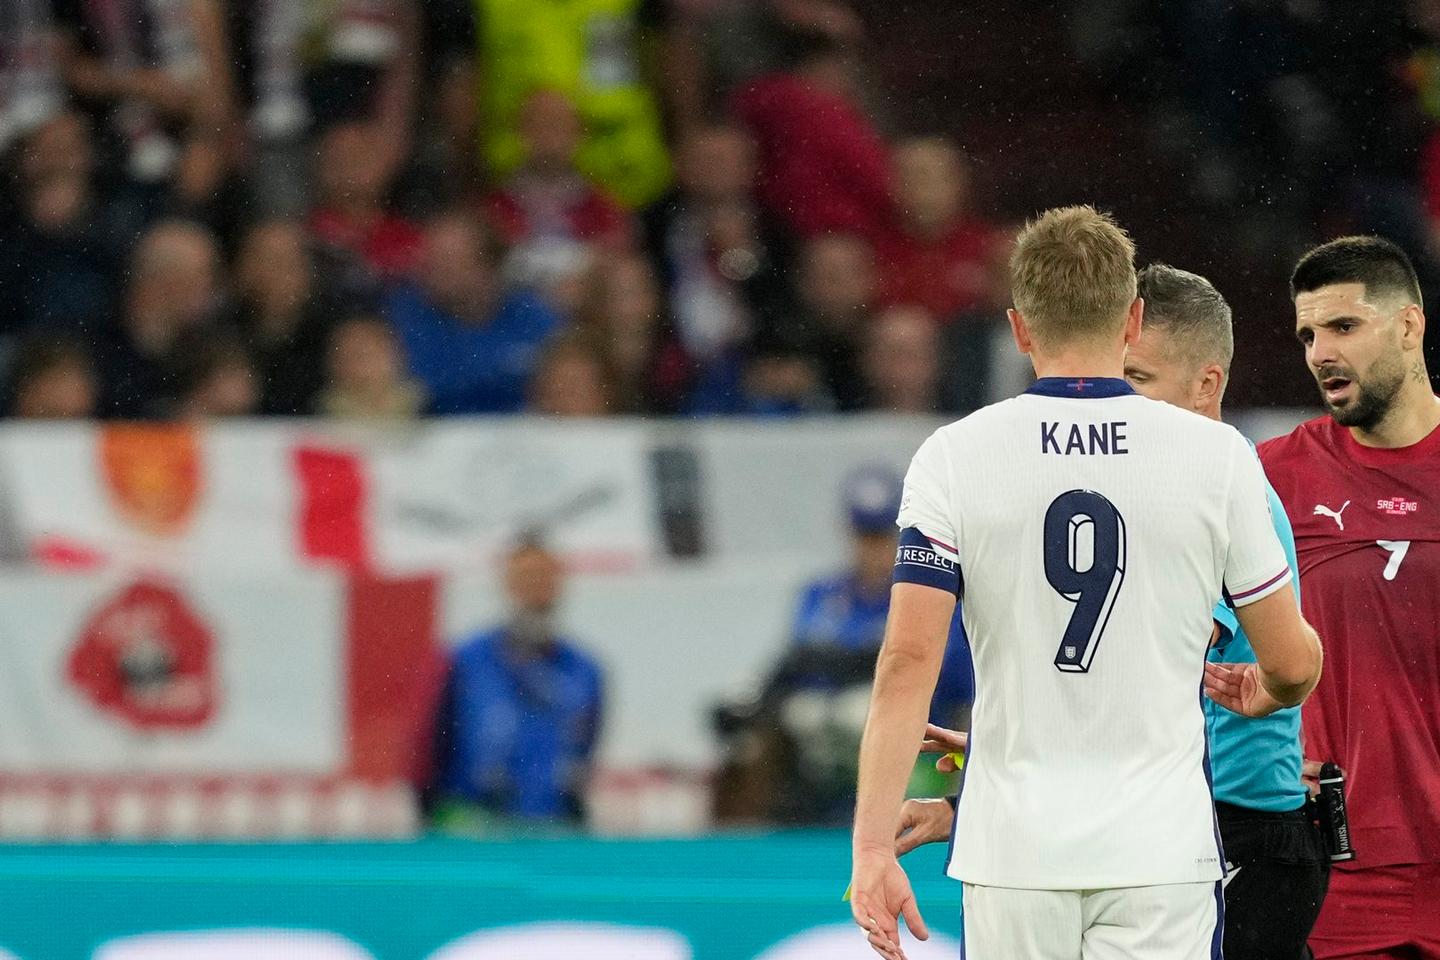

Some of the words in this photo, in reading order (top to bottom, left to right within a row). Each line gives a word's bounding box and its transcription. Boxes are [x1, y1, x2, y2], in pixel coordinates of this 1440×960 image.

[1041, 421, 1129, 456] KANE
[1043, 489, 1127, 673] 9
[1376, 540, 1410, 581] 7
